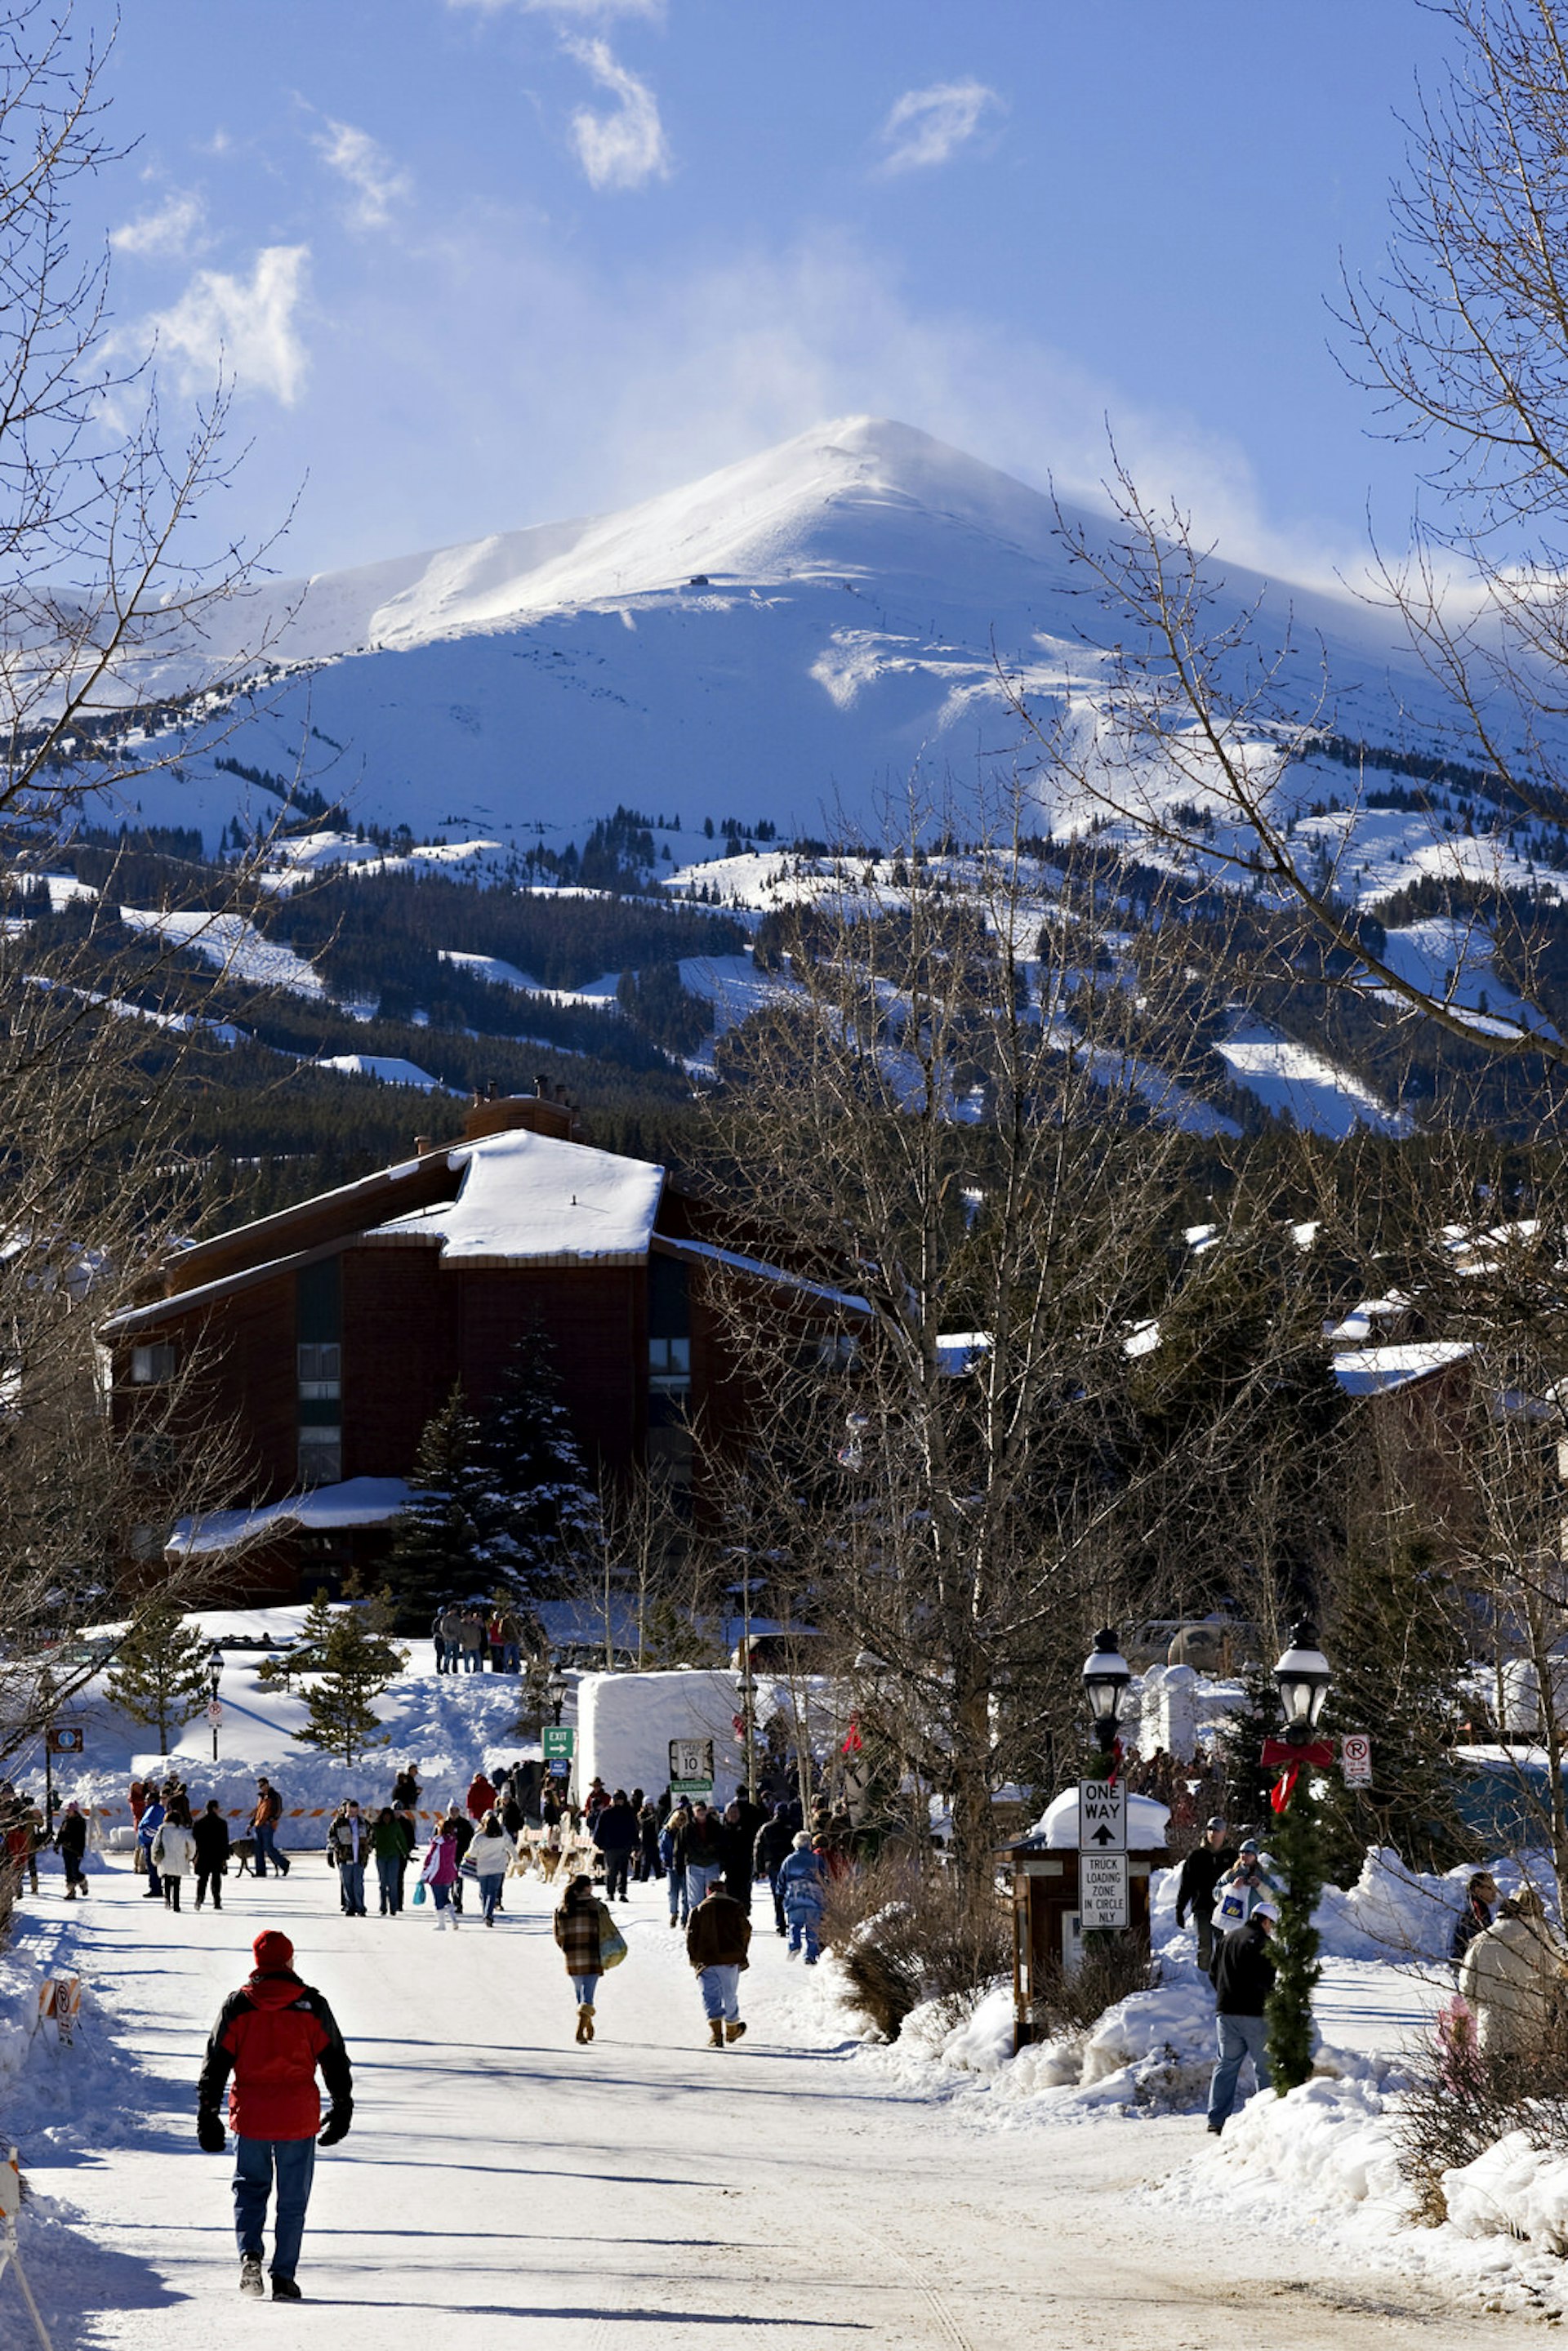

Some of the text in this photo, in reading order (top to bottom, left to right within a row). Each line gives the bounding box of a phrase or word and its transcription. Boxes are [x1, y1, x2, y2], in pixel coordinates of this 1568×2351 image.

[549, 1732, 567, 1741] EXIT
[684, 1757, 697, 1770] 10
[1086, 1785, 1120, 1800] ONE
[1085, 1804, 1120, 1819] WAY
[1089, 1859, 1118, 1870] TRUCK
[1086, 1872, 1121, 1884] LOADING
[1093, 1885, 1116, 1896] ZONE
[1084, 1899, 1124, 1909] IN CIRCLE
